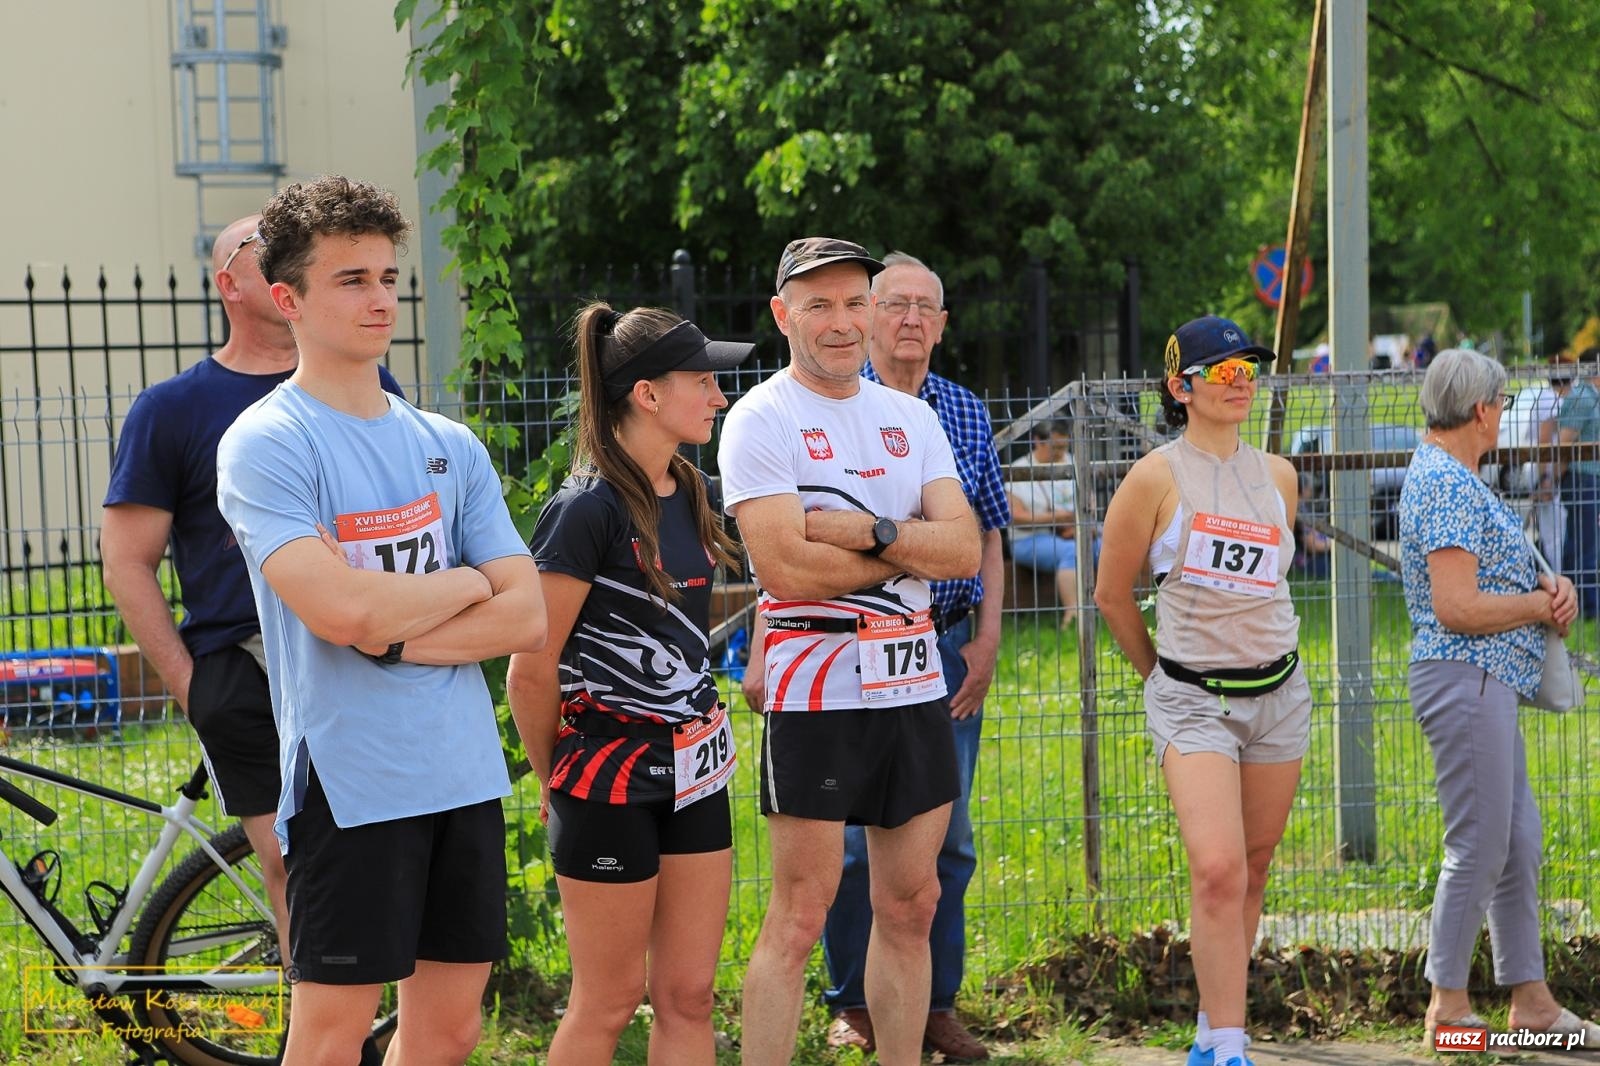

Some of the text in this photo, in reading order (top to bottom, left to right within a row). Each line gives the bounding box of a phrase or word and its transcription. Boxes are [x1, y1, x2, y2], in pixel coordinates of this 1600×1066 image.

[354, 516, 373, 526] XVI
[376, 513, 400, 524] BIEG
[401, 507, 415, 519] BEZ
[375, 531, 440, 575] 172
[1212, 539, 1264, 575] 137
[775, 619, 811, 630] Kalenji
[870, 620, 885, 628] XVI
[883, 638, 927, 676] 179
[695, 727, 728, 781] 219
